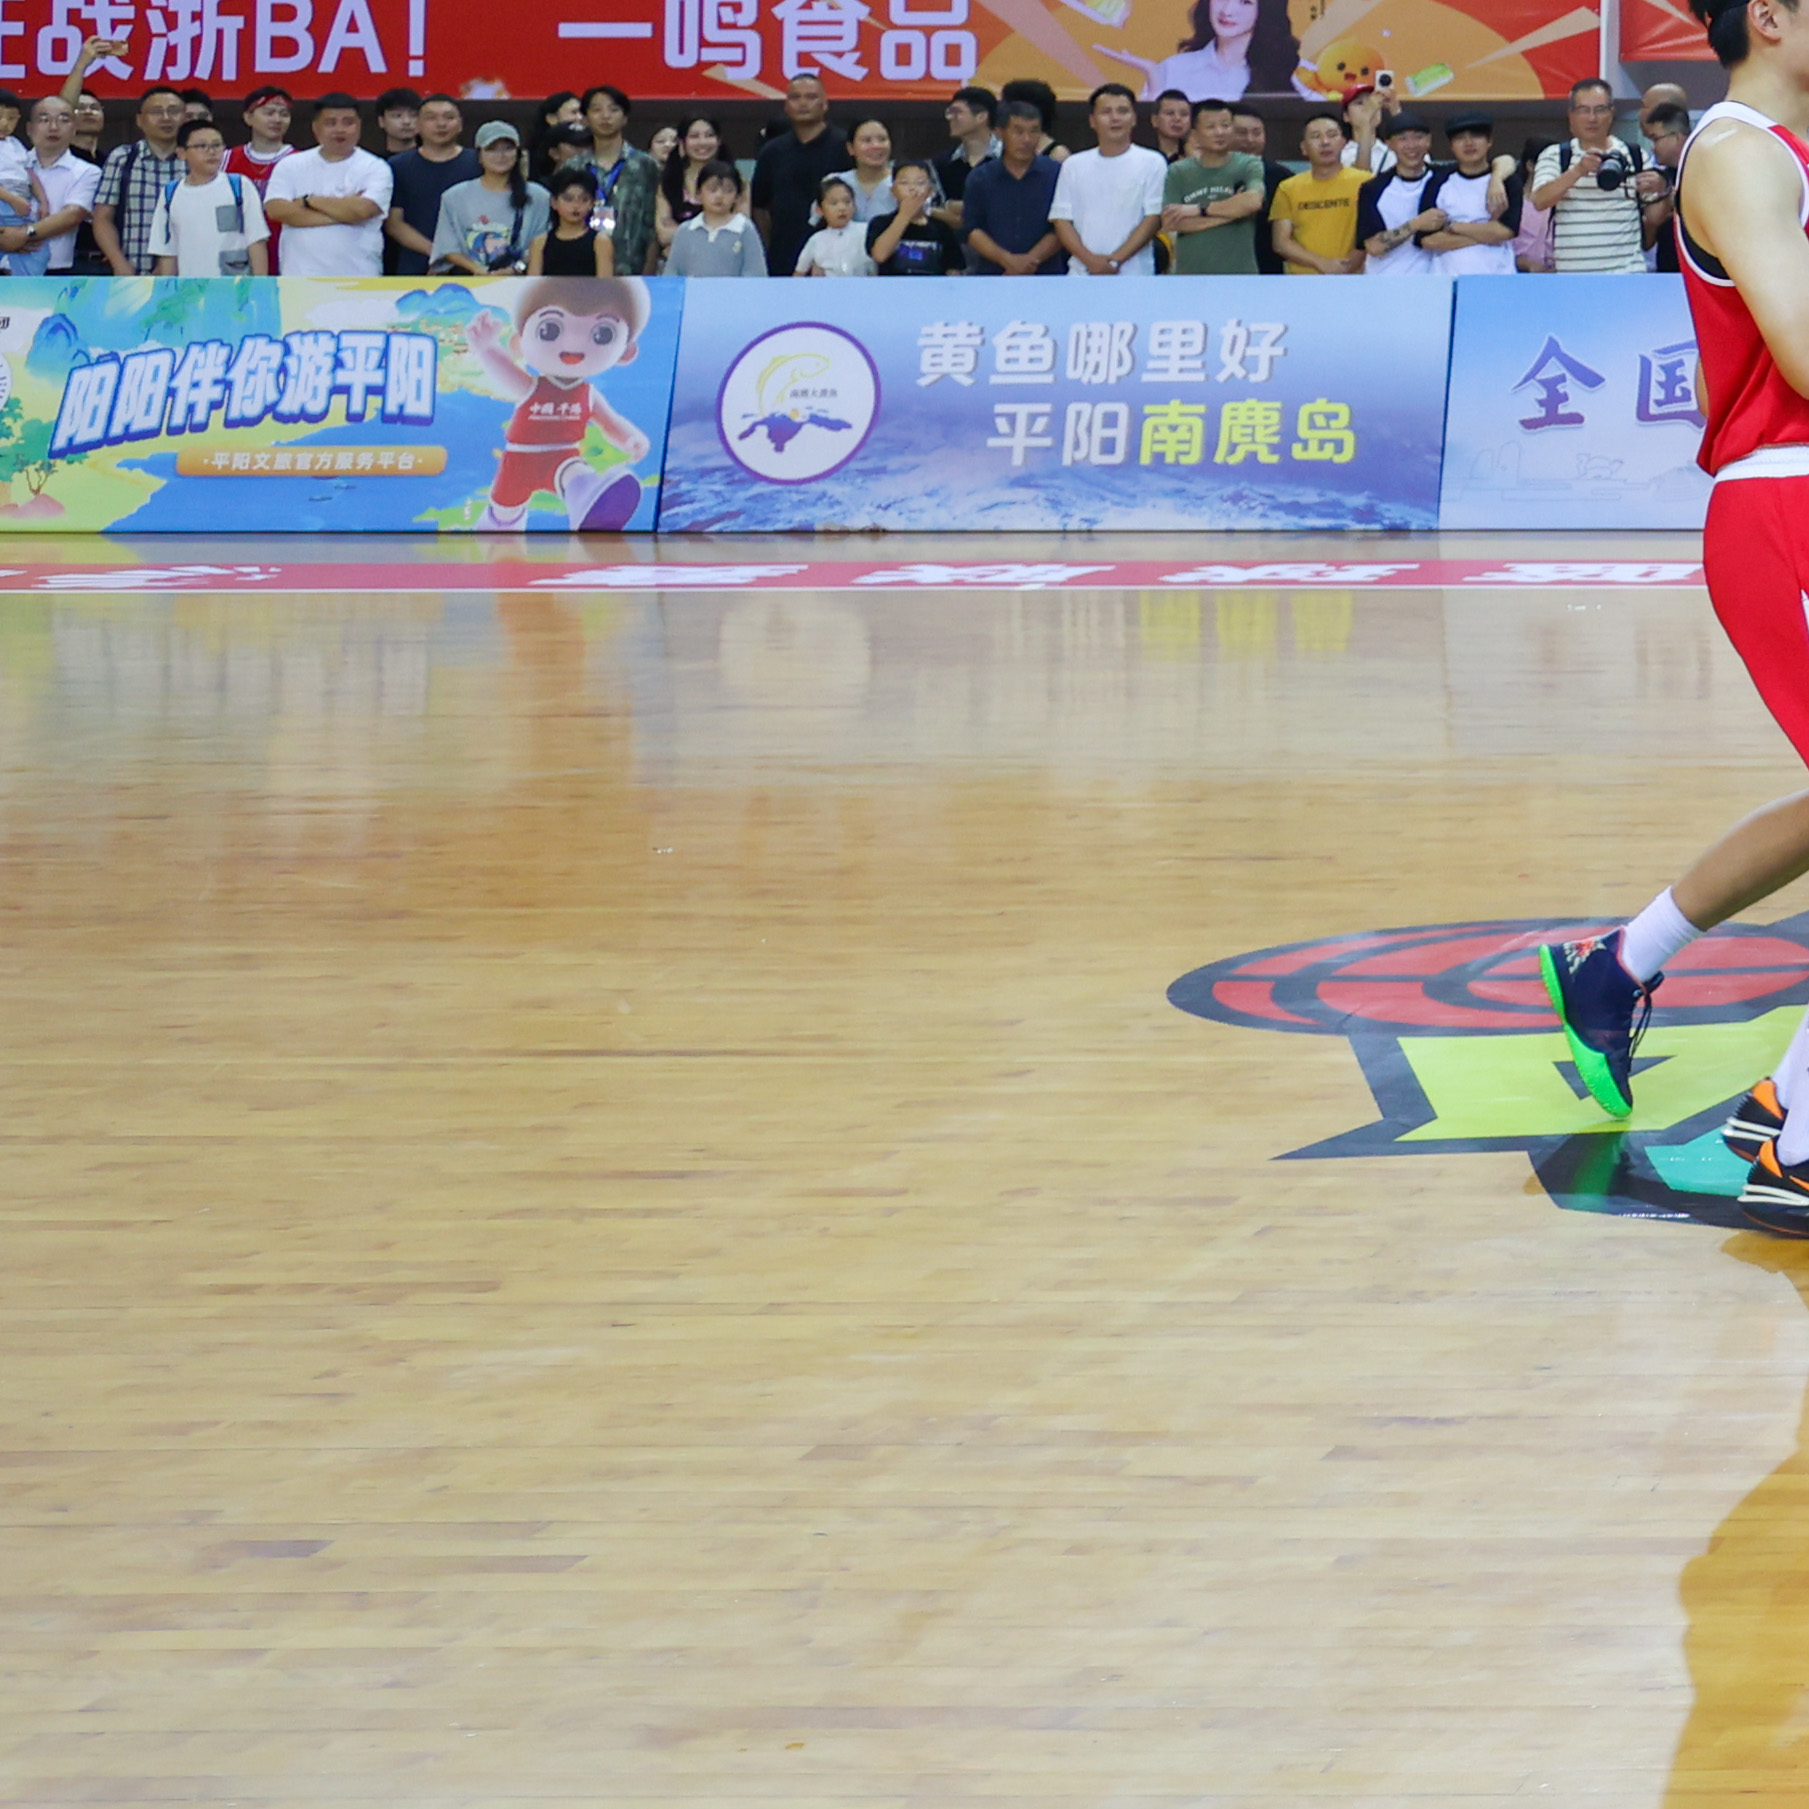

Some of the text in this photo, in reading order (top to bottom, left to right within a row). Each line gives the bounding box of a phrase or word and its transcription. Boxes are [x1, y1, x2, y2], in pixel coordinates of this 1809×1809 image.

[916, 319, 1289, 387] 黄鱼哪里好
[53, 332, 437, 454] 阳阳伴你游平阳
[210, 451, 417, 472] 平阳文旅官方服务平台
[986, 399, 1358, 467] 平阳南麂岛
